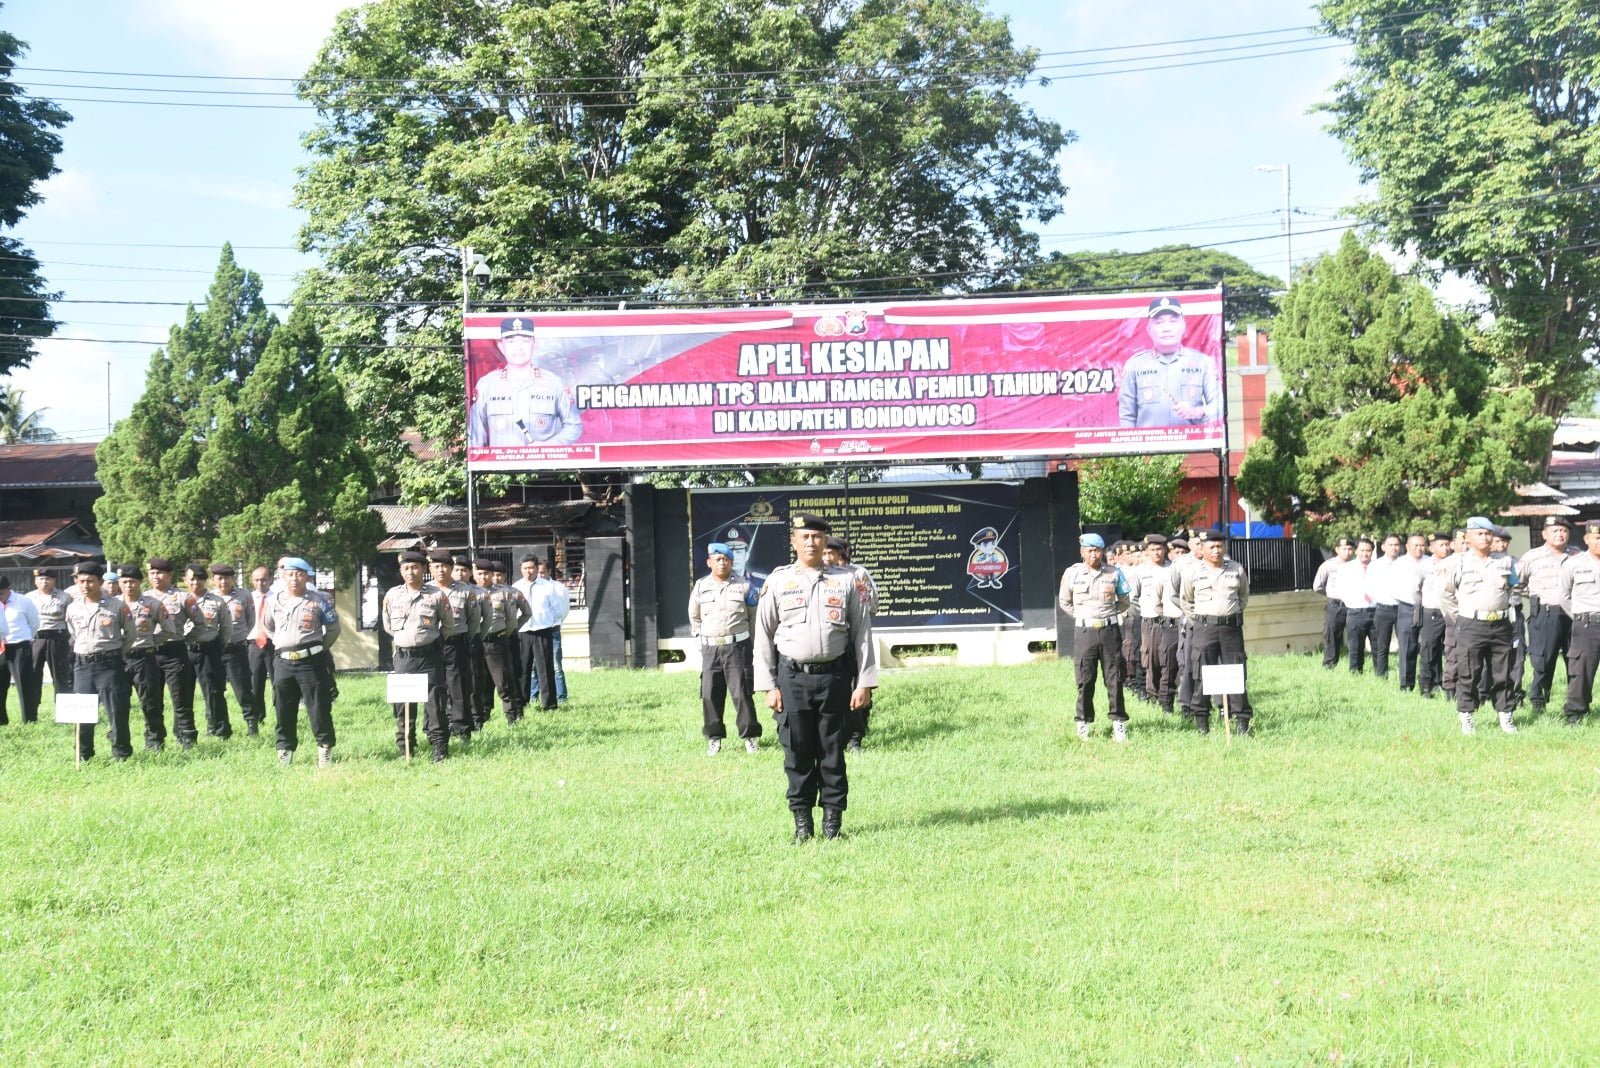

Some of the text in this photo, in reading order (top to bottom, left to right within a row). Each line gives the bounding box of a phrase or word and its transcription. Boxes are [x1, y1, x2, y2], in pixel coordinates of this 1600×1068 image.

[738, 338, 950, 376] APEL KESIAPAN
[578, 369, 1114, 409] PENGAMANAN TPS DALAM RANGKA PEMILU TAHUN 2024
[714, 404, 977, 433] DI KABUPATEN BONDOWOSO
[789, 508, 824, 518] JERAL
[825, 508, 841, 518] POL.
[858, 507, 884, 516] LISTYO
[884, 506, 906, 515] SIGIT
[799, 497, 836, 508] PROGRAM
[837, 496, 876, 506] PRORITAS
[878, 496, 909, 505] KAPOLRI
